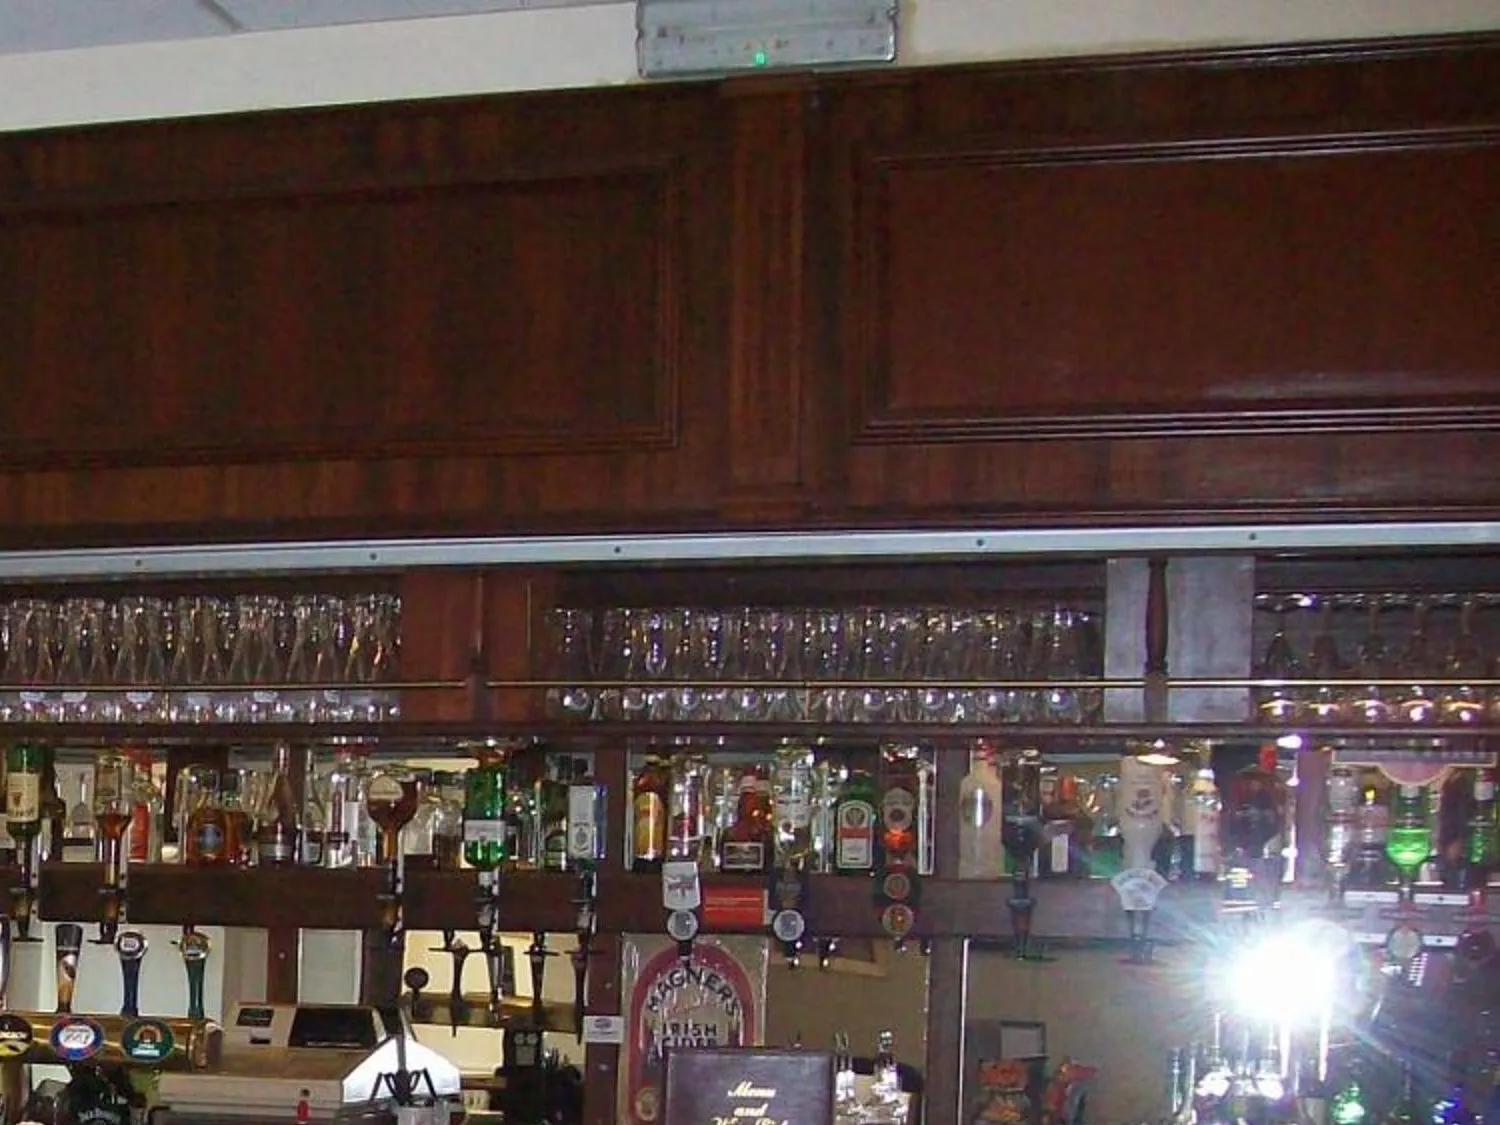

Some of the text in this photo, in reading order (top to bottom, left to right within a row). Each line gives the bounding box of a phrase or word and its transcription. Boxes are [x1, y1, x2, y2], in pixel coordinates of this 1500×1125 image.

[646, 965, 742, 1018] MAGNERS
[661, 1022, 718, 1036] IRISH
[727, 1080, 777, 1099] Menu
[732, 1103, 768, 1117] and
